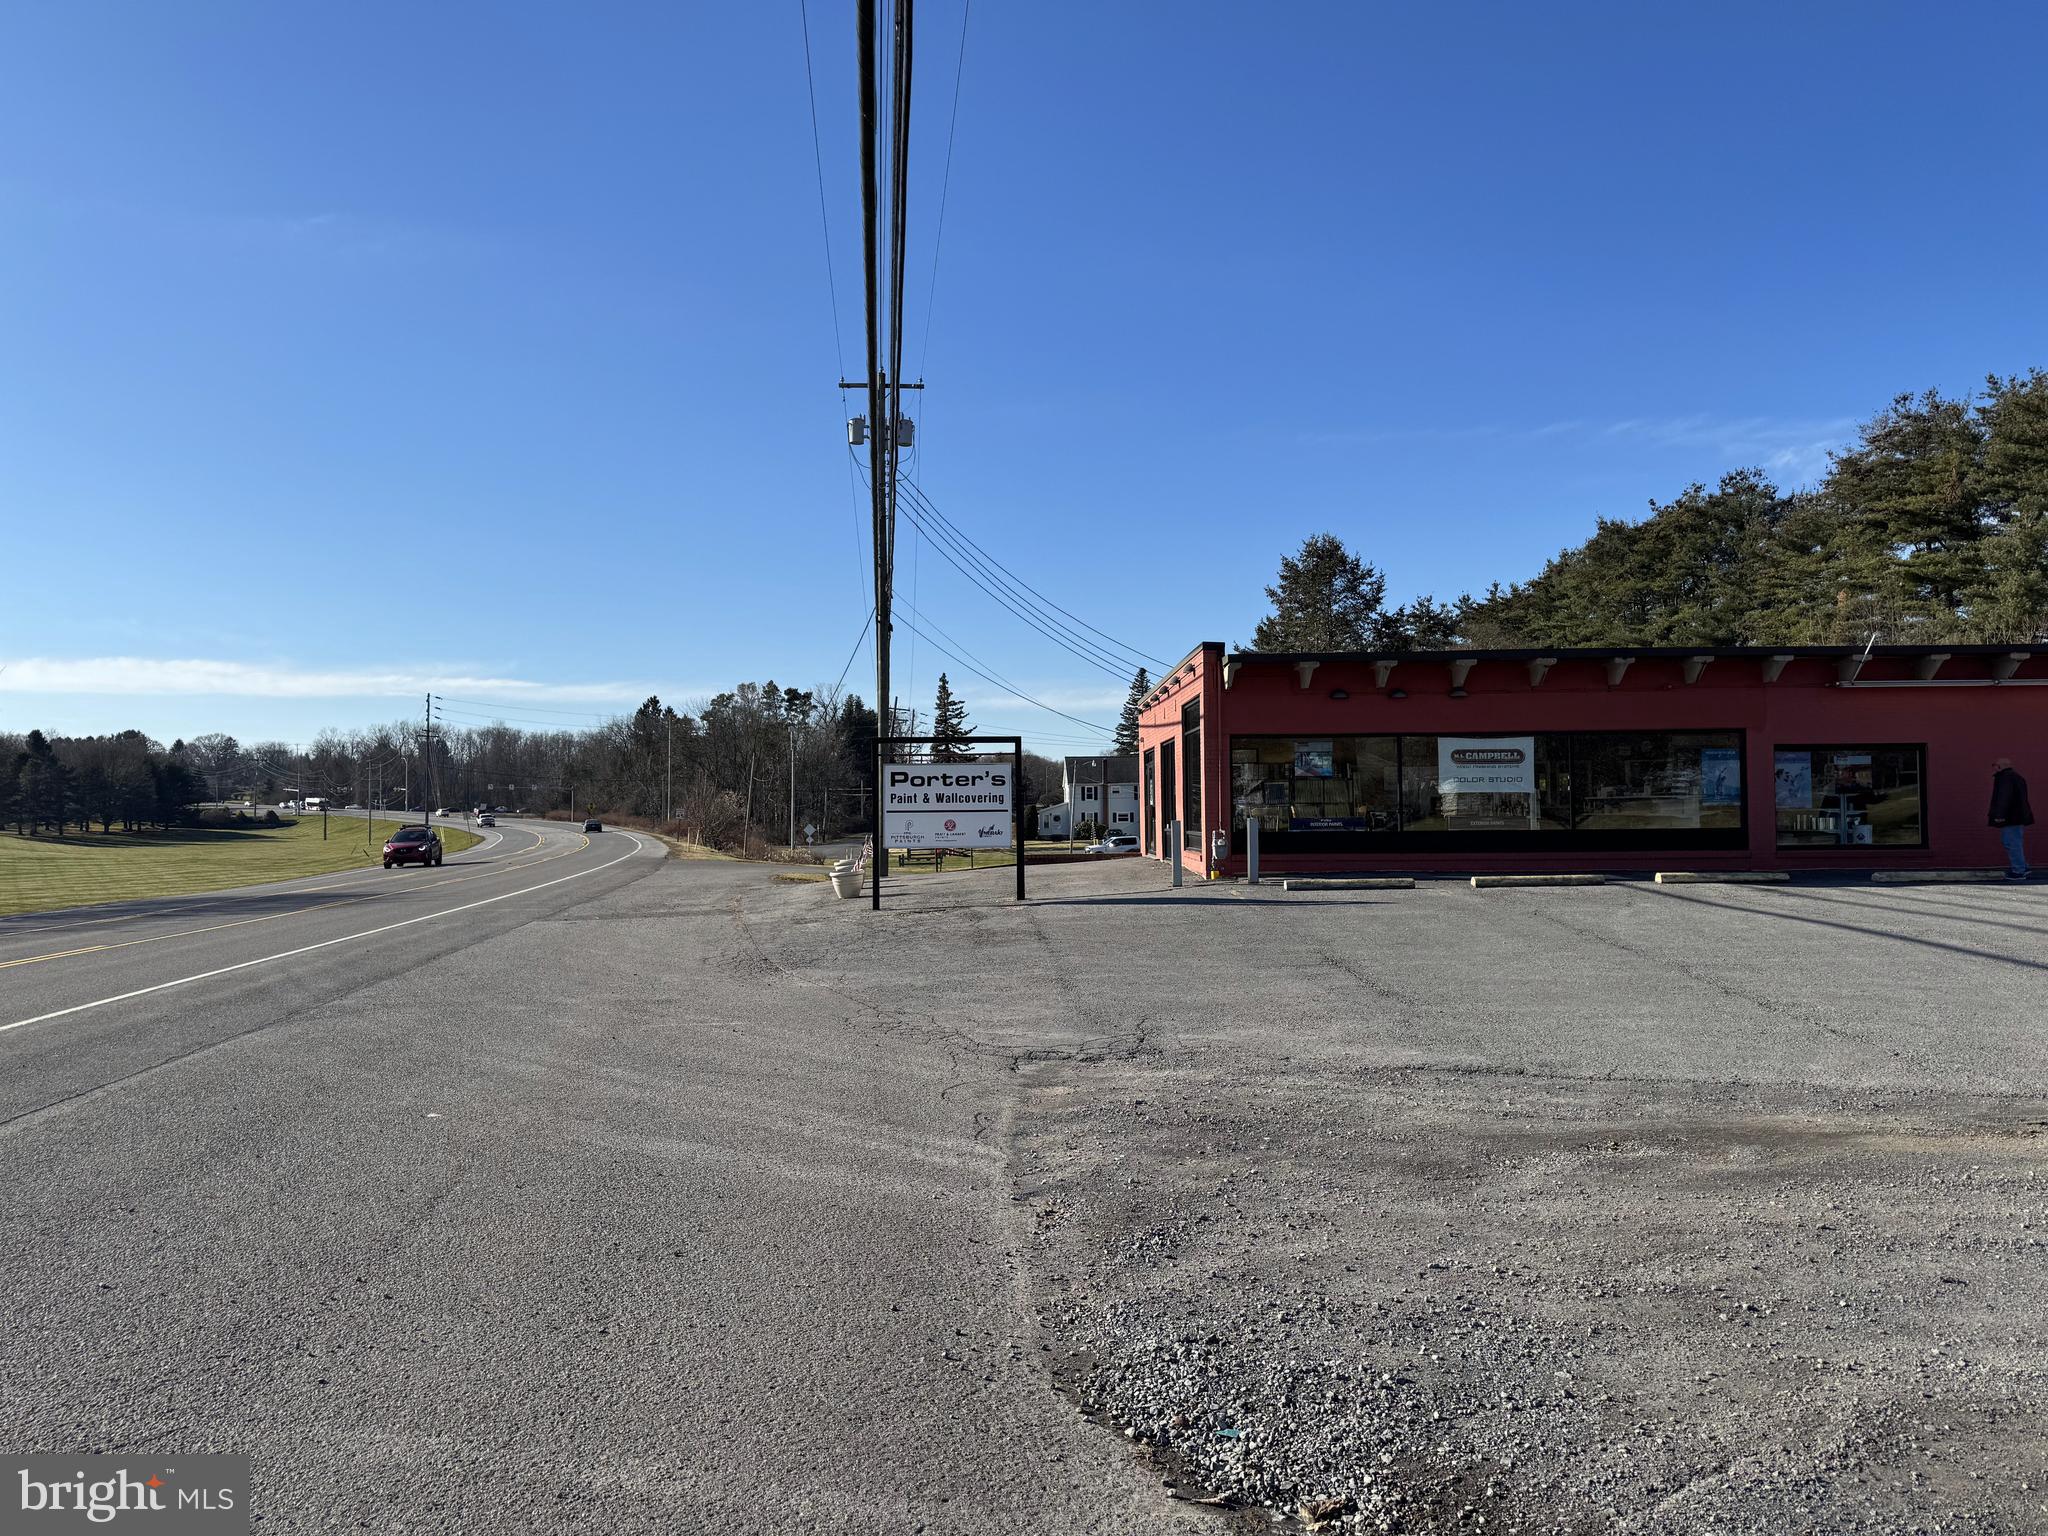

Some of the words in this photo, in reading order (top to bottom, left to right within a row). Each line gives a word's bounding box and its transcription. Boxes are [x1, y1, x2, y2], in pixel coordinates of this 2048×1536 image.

[1465, 752, 1520, 760] CAMPBELL
[890, 771, 1006, 787] Porter's
[890, 793, 917, 804] Paint
[922, 793, 930, 804] &
[935, 792, 1004, 805] Wallcovering
